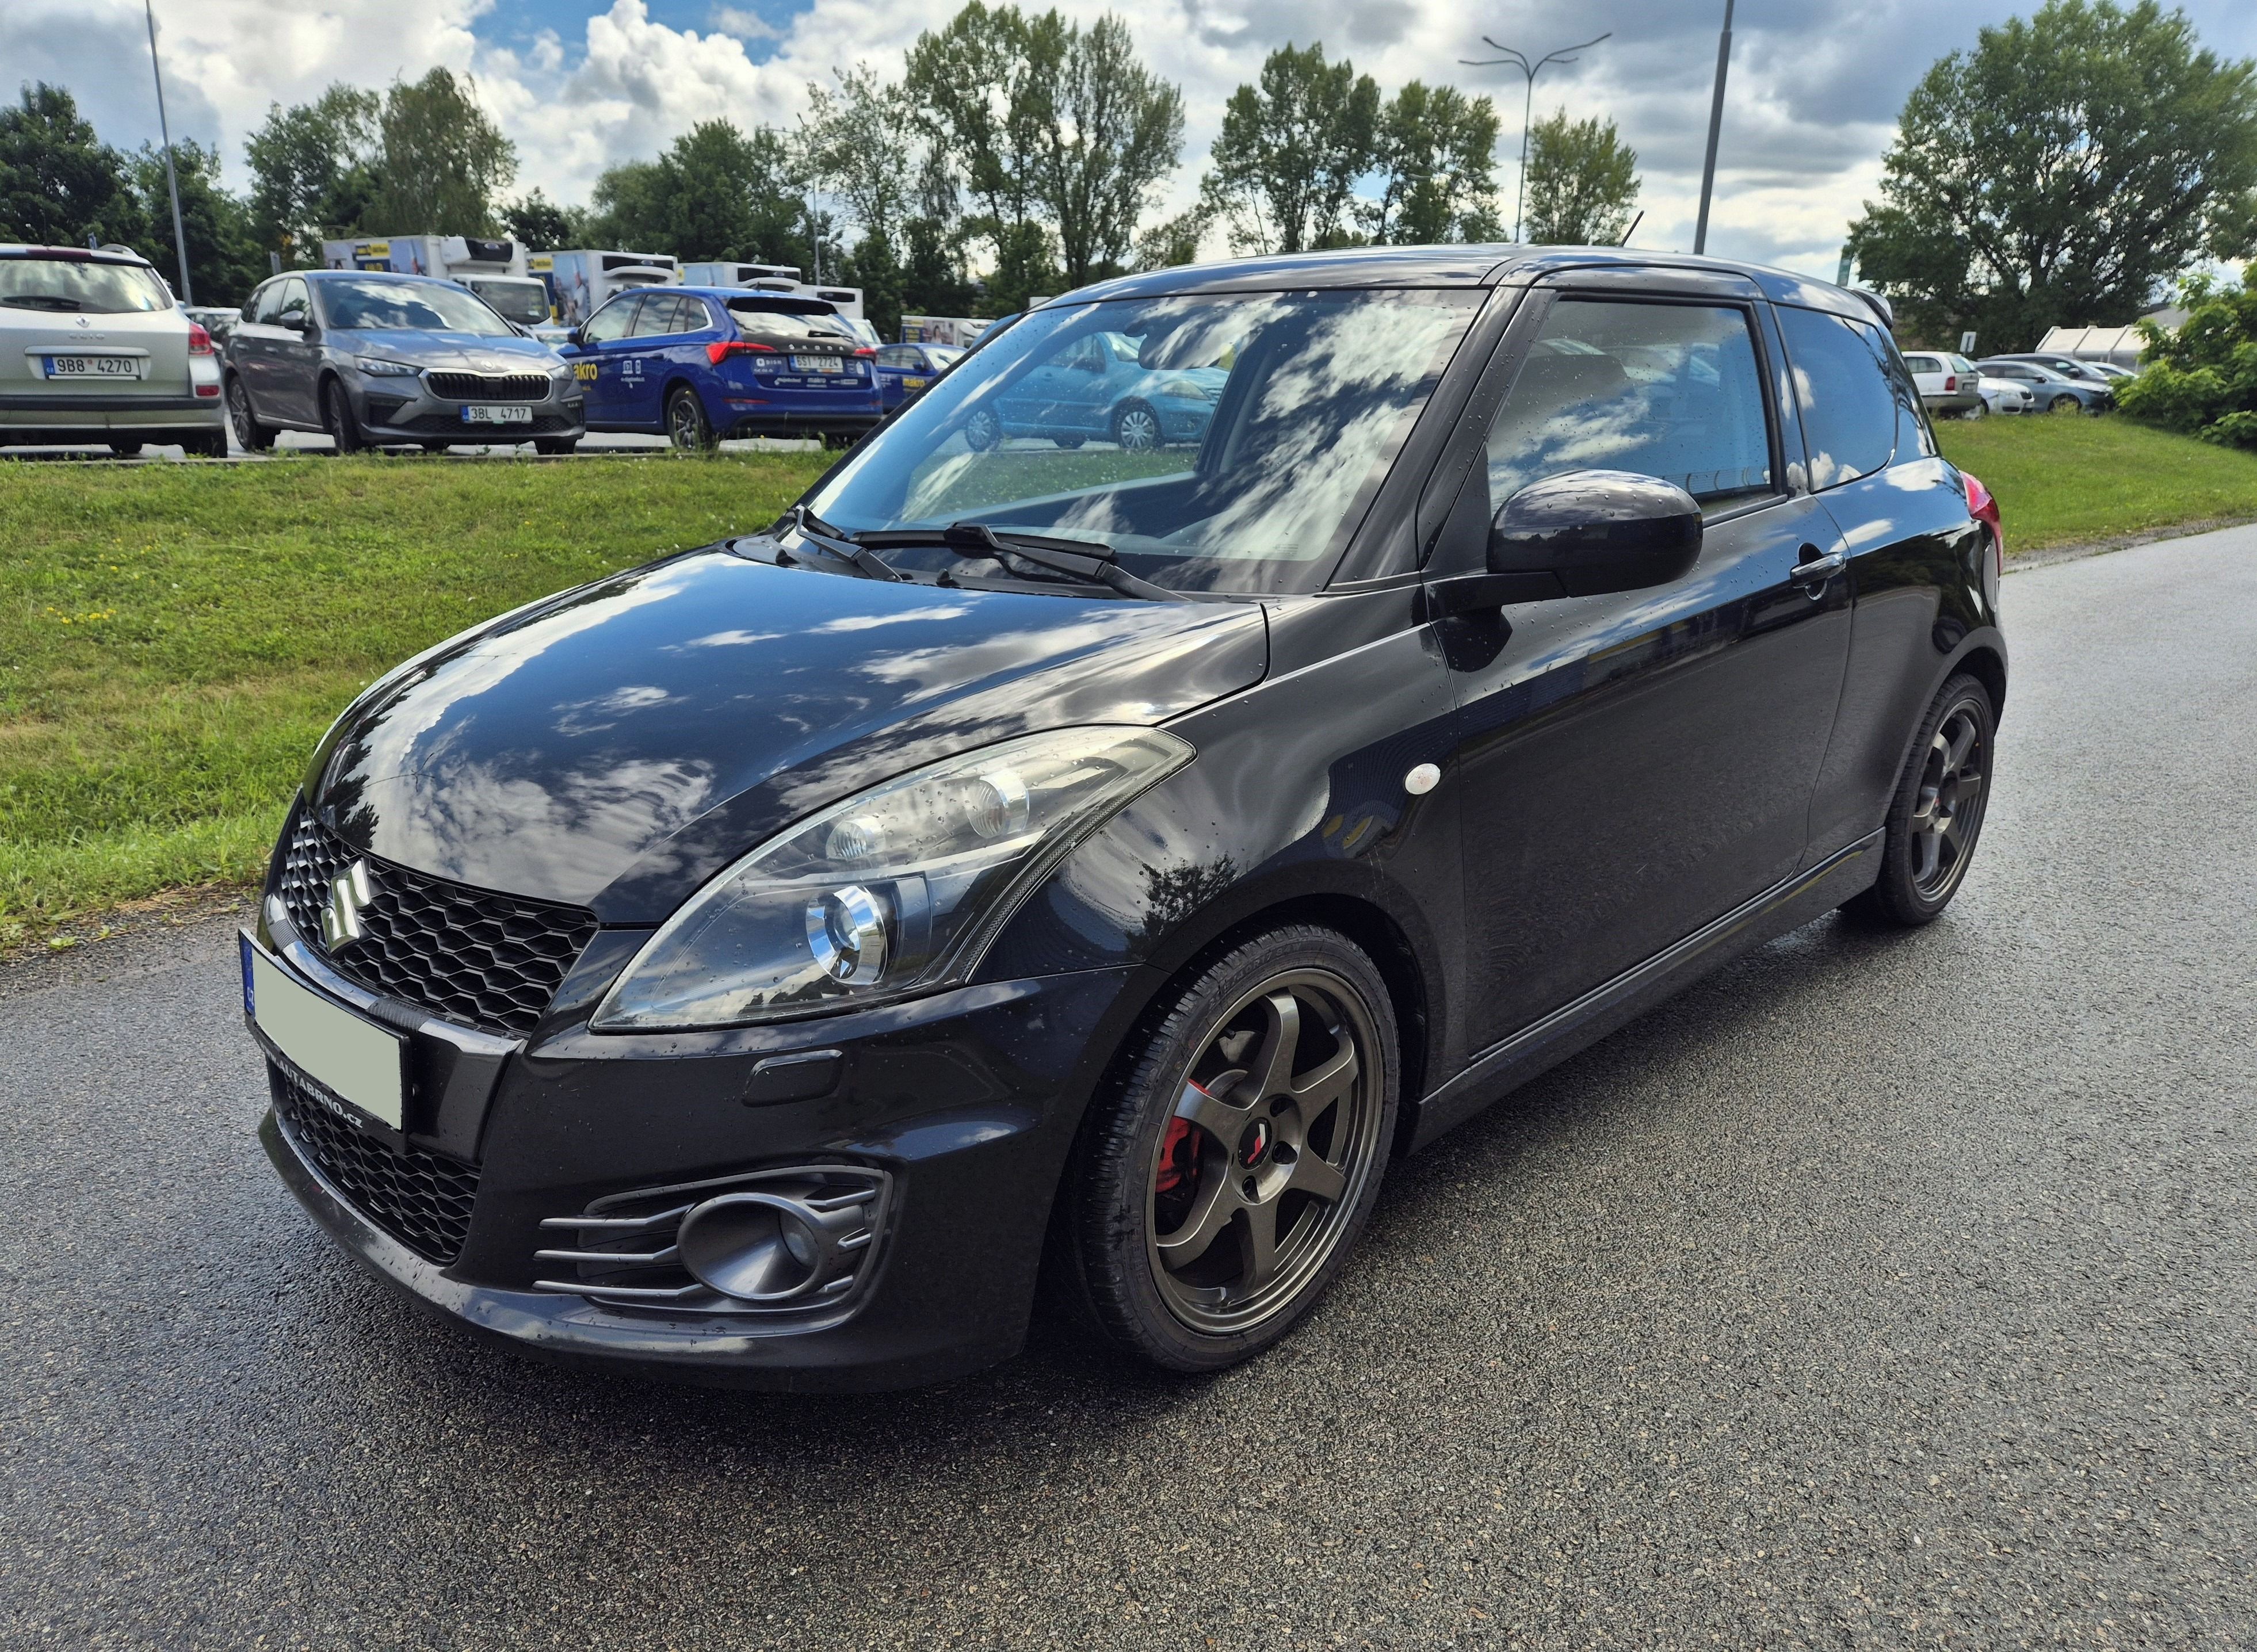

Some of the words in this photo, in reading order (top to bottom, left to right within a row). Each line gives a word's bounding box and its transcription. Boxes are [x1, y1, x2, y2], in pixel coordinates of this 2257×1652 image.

[57, 359, 85, 372] 9B8
[97, 360, 132, 373] 4270
[573, 361, 598, 380] akro
[471, 408, 492, 419] 3BL
[500, 408, 526, 419] 4717
